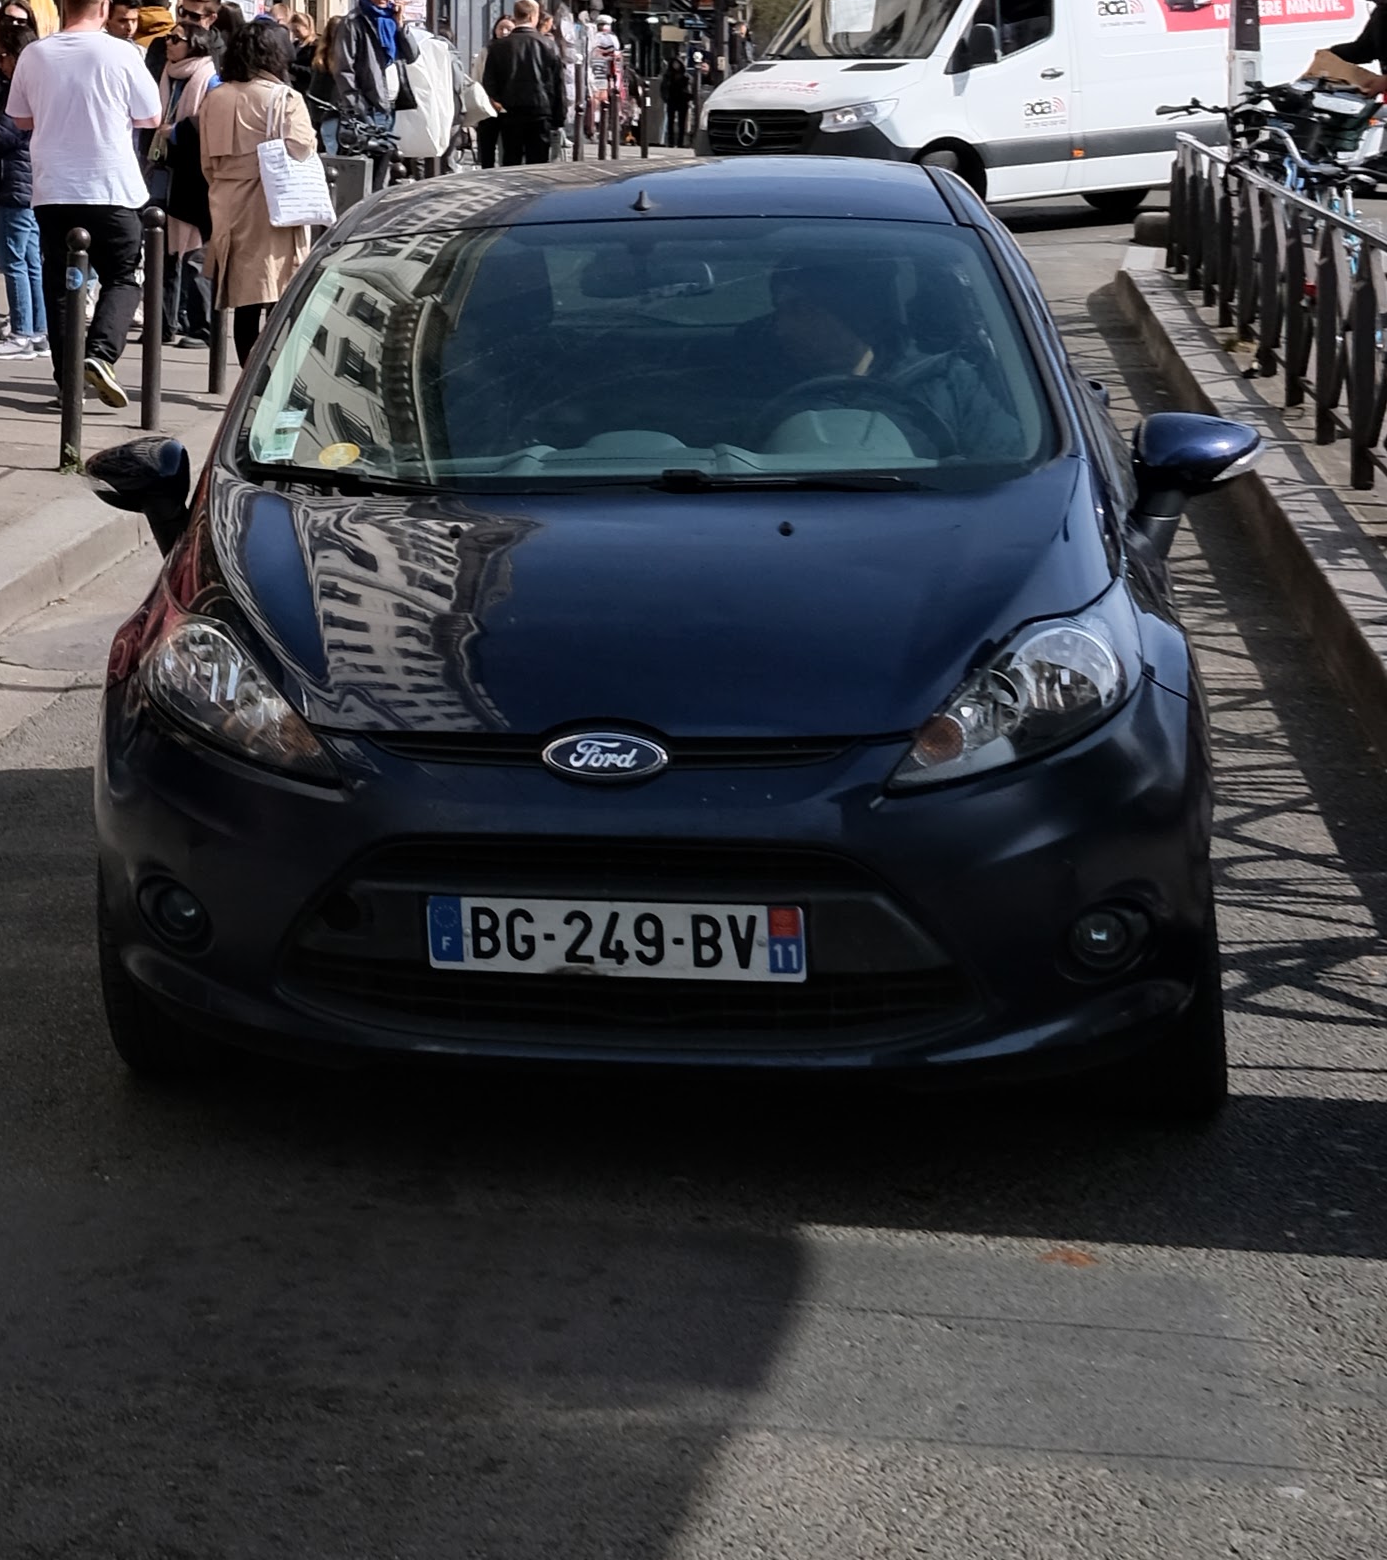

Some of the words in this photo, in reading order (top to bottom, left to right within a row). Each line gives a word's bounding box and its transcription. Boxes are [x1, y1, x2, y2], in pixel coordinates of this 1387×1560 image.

[569, 739, 638, 768] Ford
[441, 935, 452, 952] F
[470, 906, 757, 970] BG-249-BV
[773, 942, 799, 970] 11
